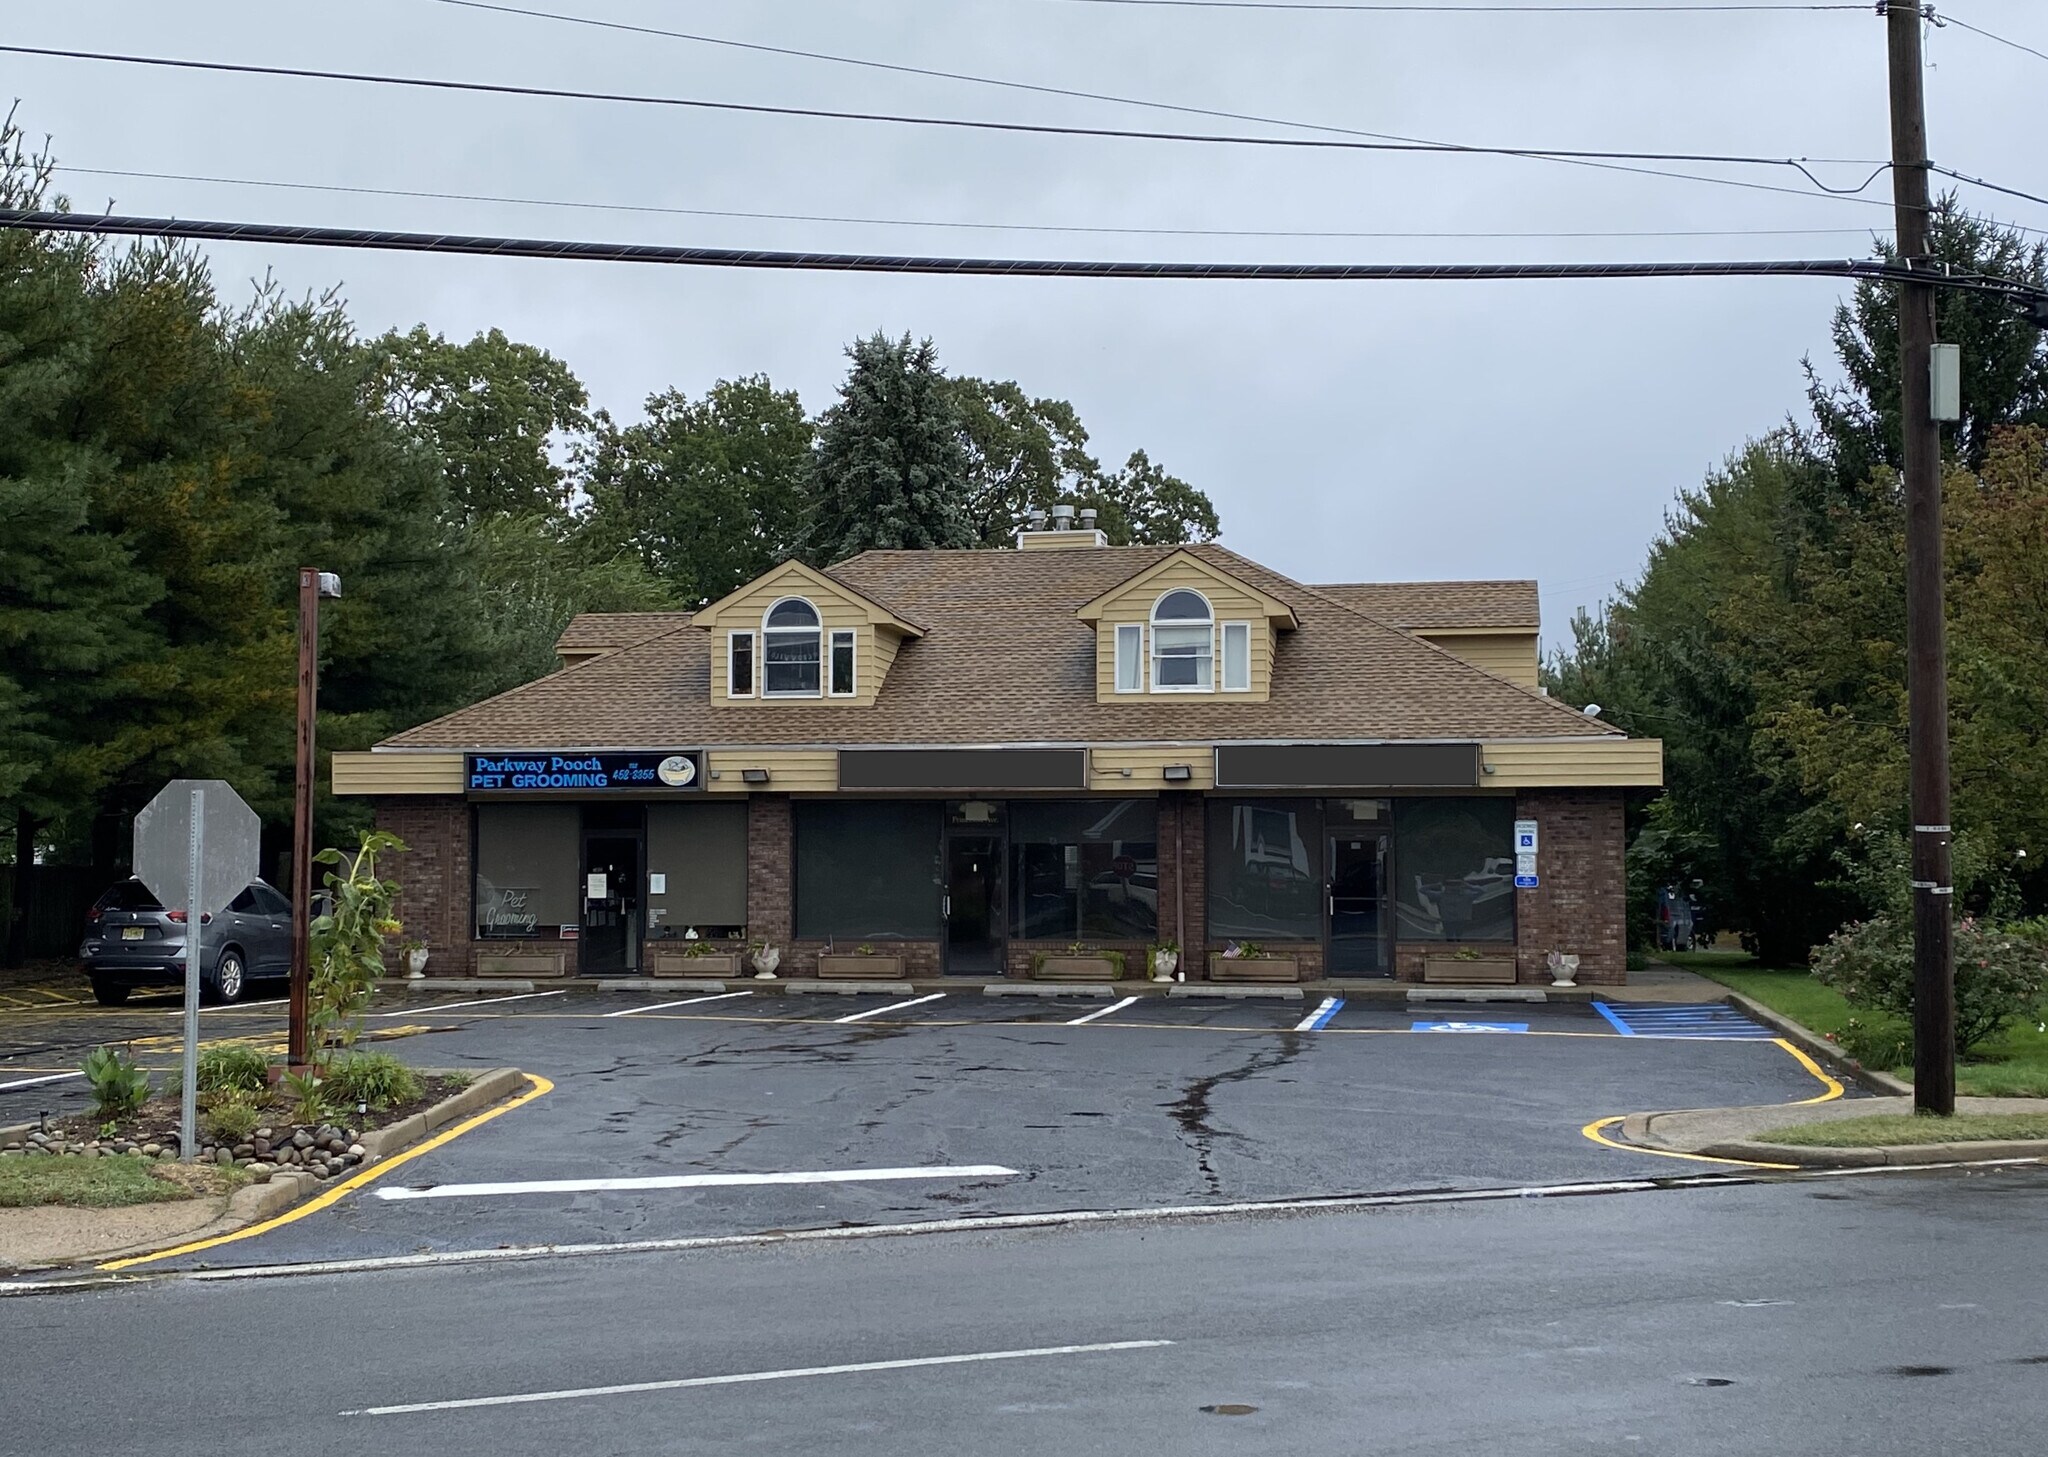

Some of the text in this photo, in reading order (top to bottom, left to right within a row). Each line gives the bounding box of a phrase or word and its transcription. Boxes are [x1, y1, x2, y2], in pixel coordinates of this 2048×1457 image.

[476, 756, 602, 773] Parkway Pooch
[471, 773, 608, 788] PET GROOMING
[501, 889, 527, 908] Pet
[486, 907, 538, 932] Grooming
